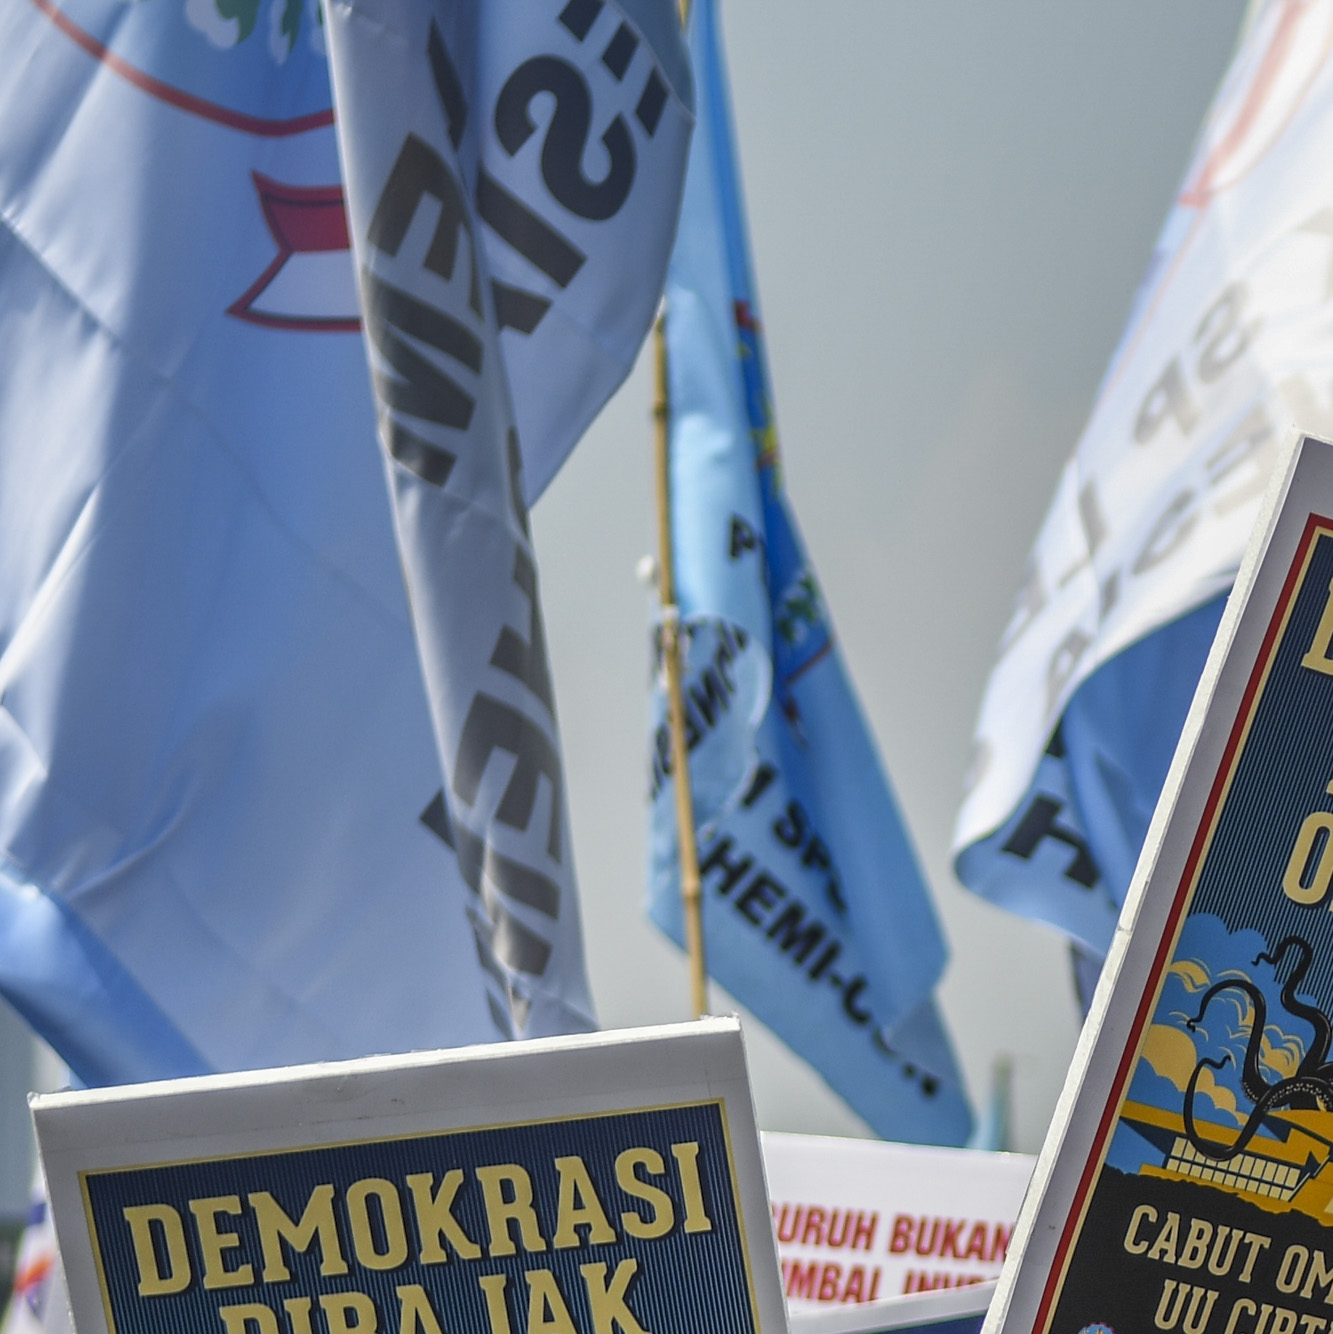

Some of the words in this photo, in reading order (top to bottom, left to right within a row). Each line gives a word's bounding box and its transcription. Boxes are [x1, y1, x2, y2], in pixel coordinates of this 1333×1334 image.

[124, 1141, 712, 1297] DEMOKRASI
[771, 1203, 880, 1252] URUH
[1123, 1204, 1271, 1285] CABUT
